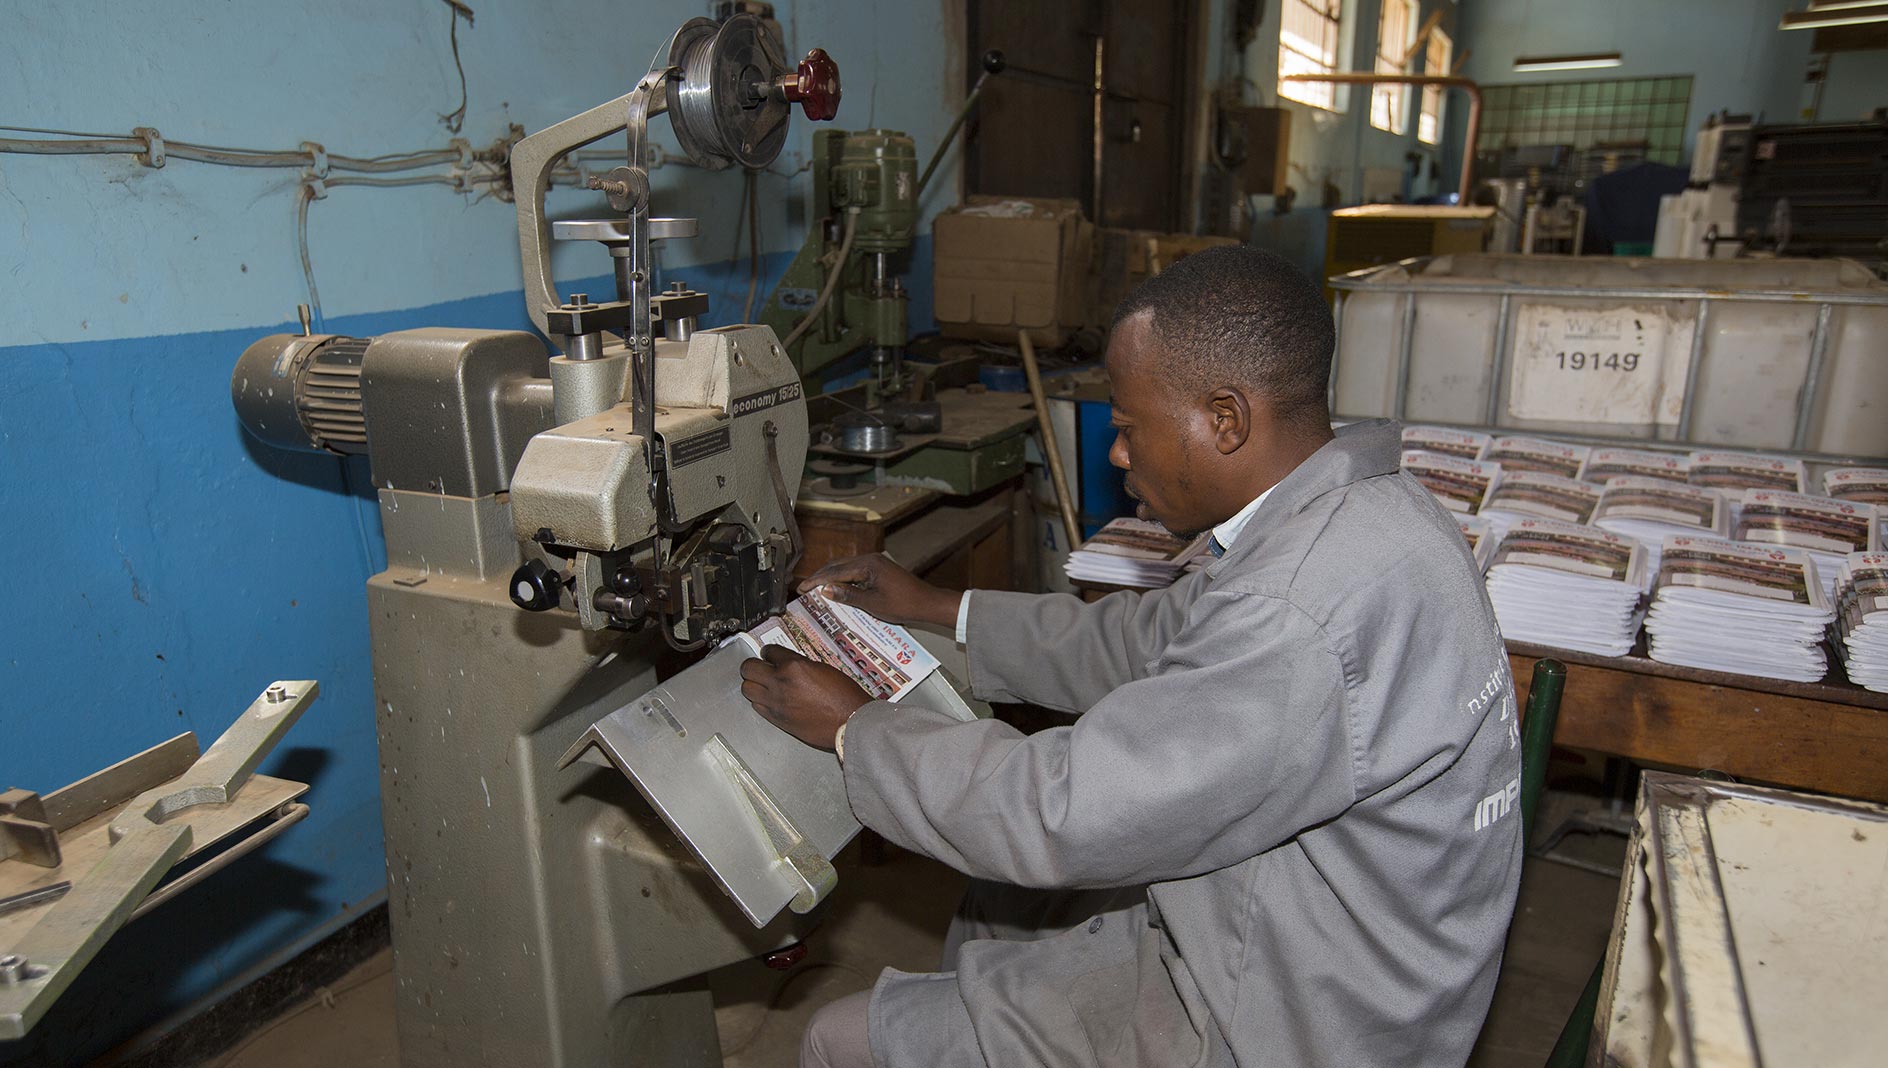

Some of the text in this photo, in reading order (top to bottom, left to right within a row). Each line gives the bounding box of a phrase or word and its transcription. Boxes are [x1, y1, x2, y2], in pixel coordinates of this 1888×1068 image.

[1556, 352, 1641, 372] 19149
[734, 392, 777, 414] economy
[883, 625, 916, 657] IMARA
[1474, 772, 1521, 832] IMP
